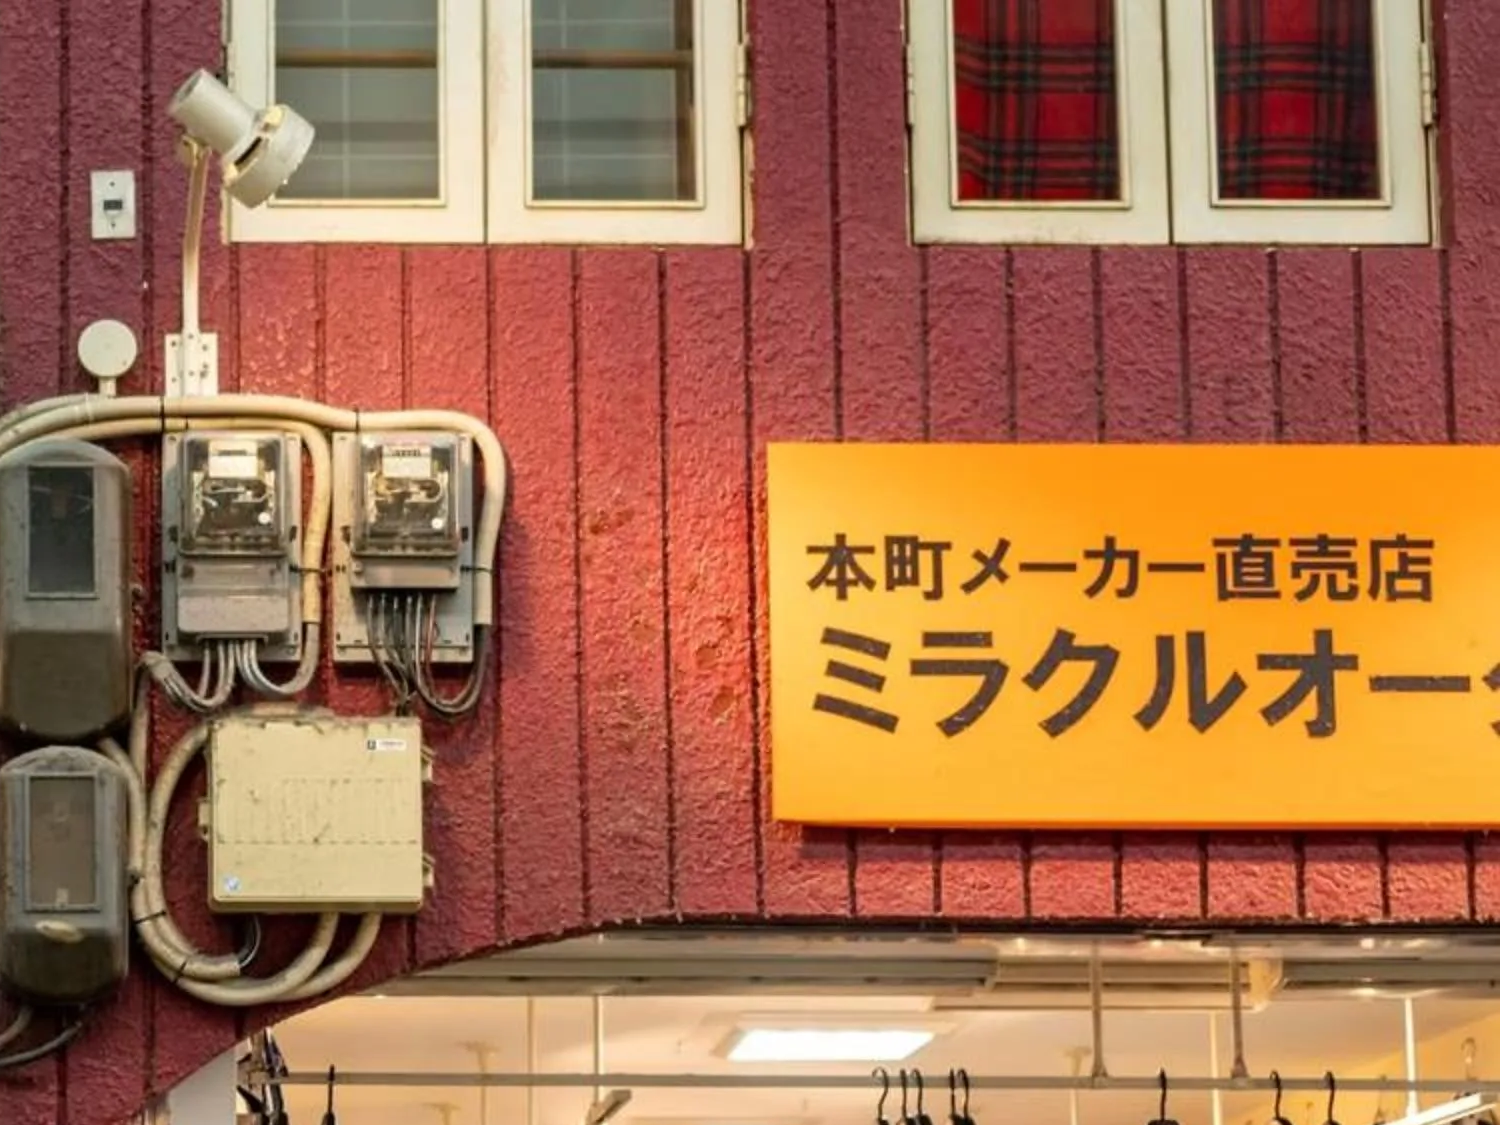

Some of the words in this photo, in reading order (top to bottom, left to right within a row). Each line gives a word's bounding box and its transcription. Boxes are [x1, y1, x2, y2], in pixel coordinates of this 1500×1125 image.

[806, 533, 1435, 602] 本町メーカー直売店
[812, 627, 1500, 739] ミラクルオー
